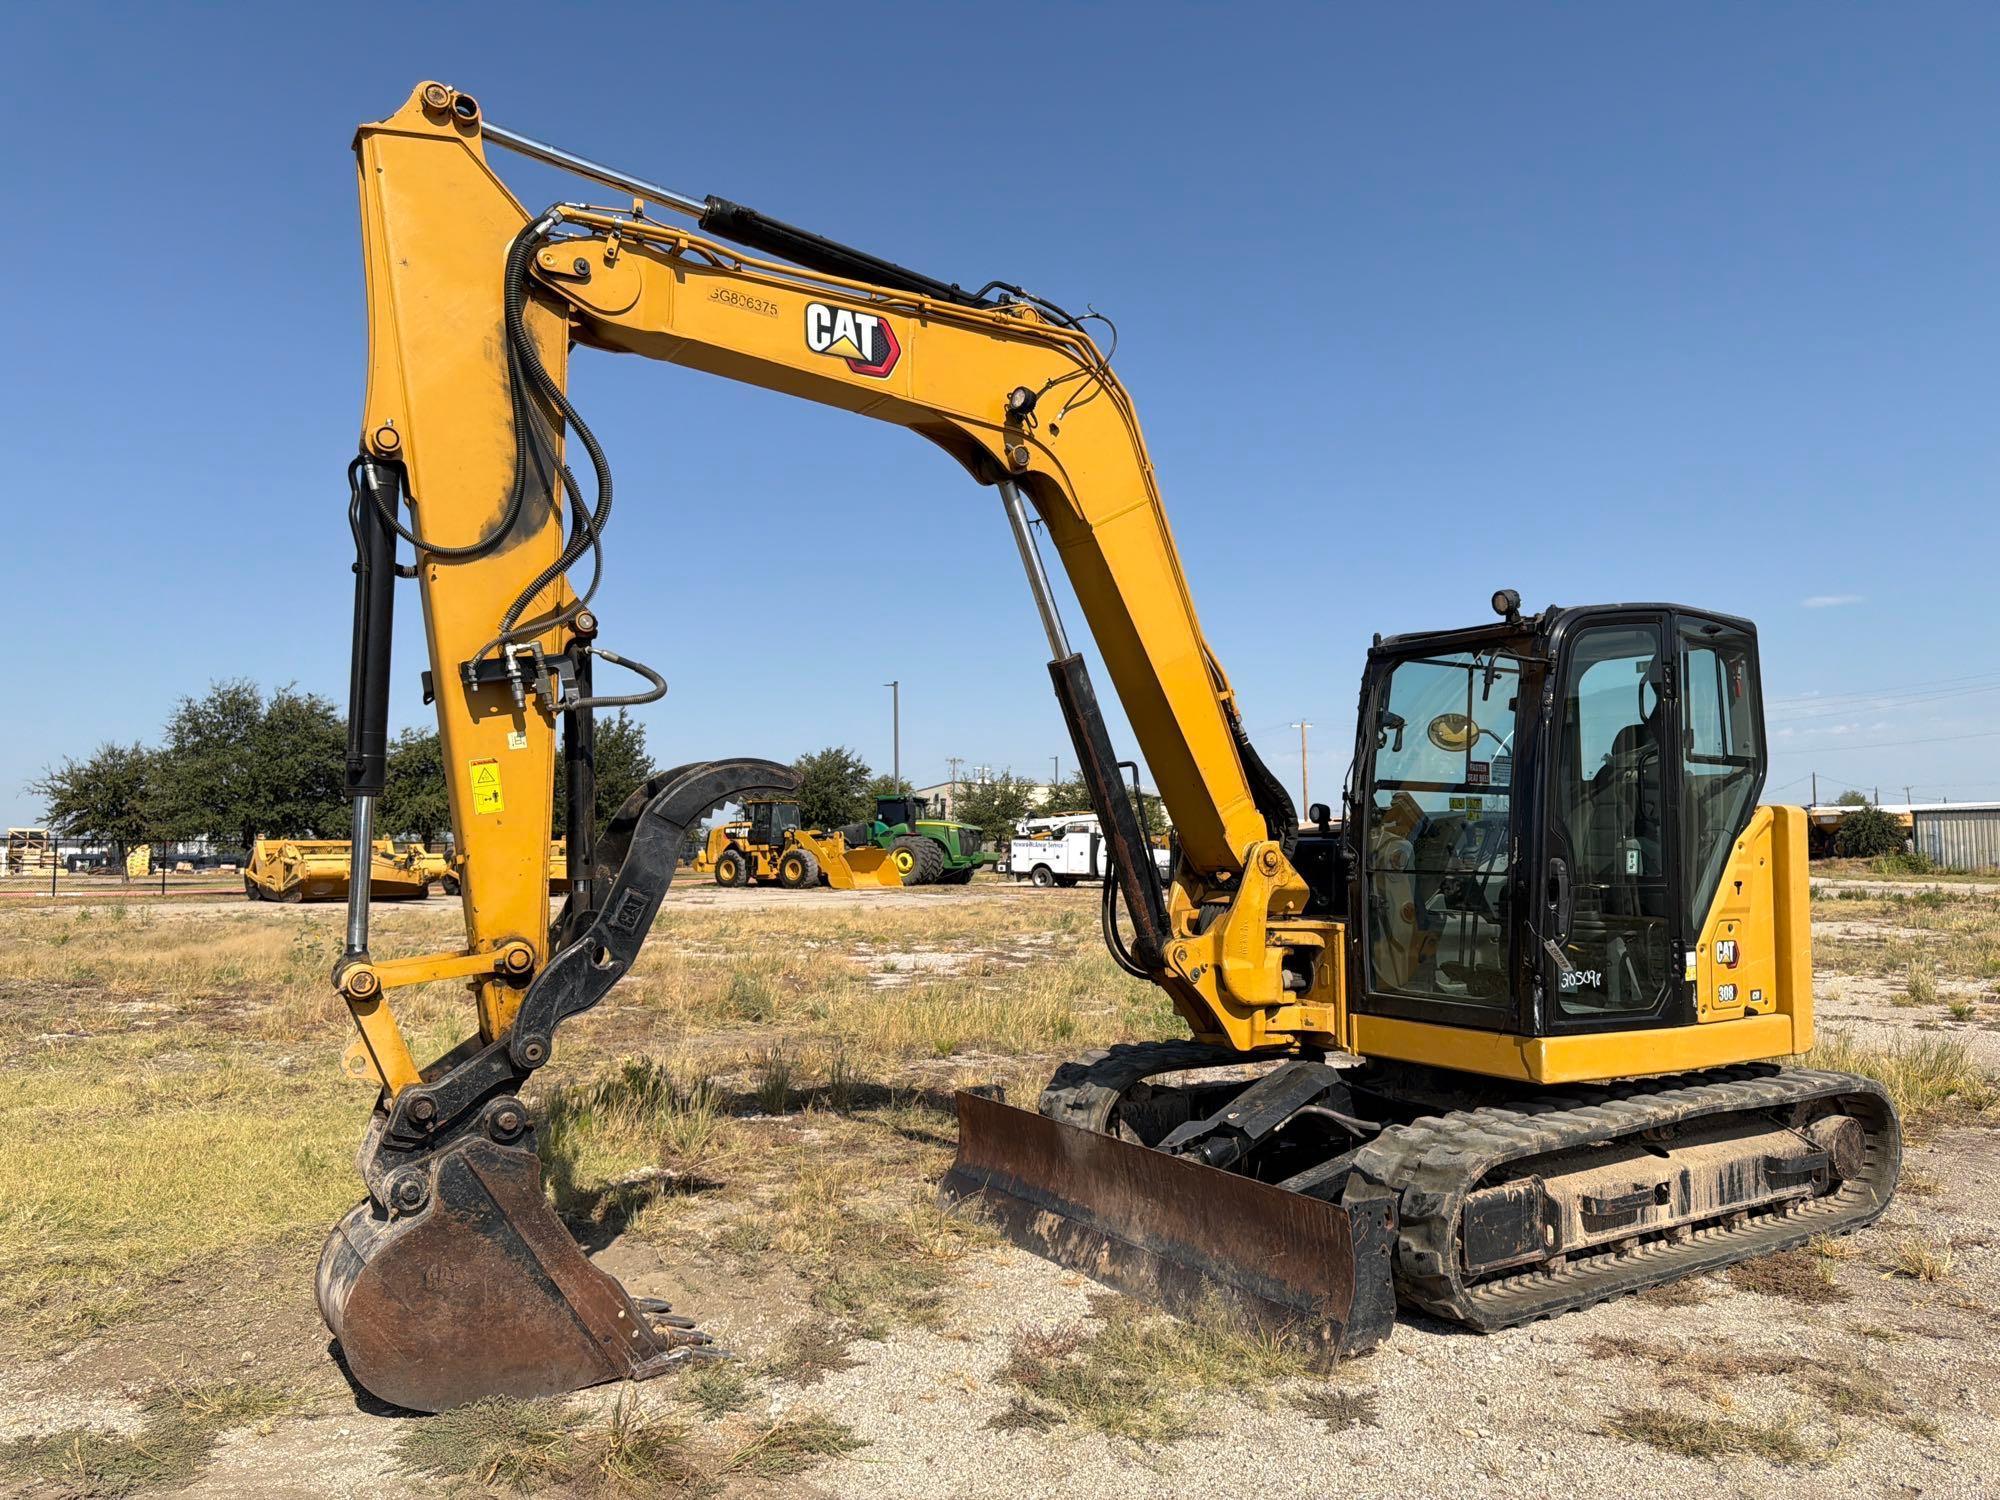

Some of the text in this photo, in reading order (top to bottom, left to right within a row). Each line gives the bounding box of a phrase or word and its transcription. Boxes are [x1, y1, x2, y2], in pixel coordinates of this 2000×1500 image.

[807, 303, 878, 362] CAT
[1716, 941, 1734, 962] CAT
[1719, 985, 1734, 1001] 308
